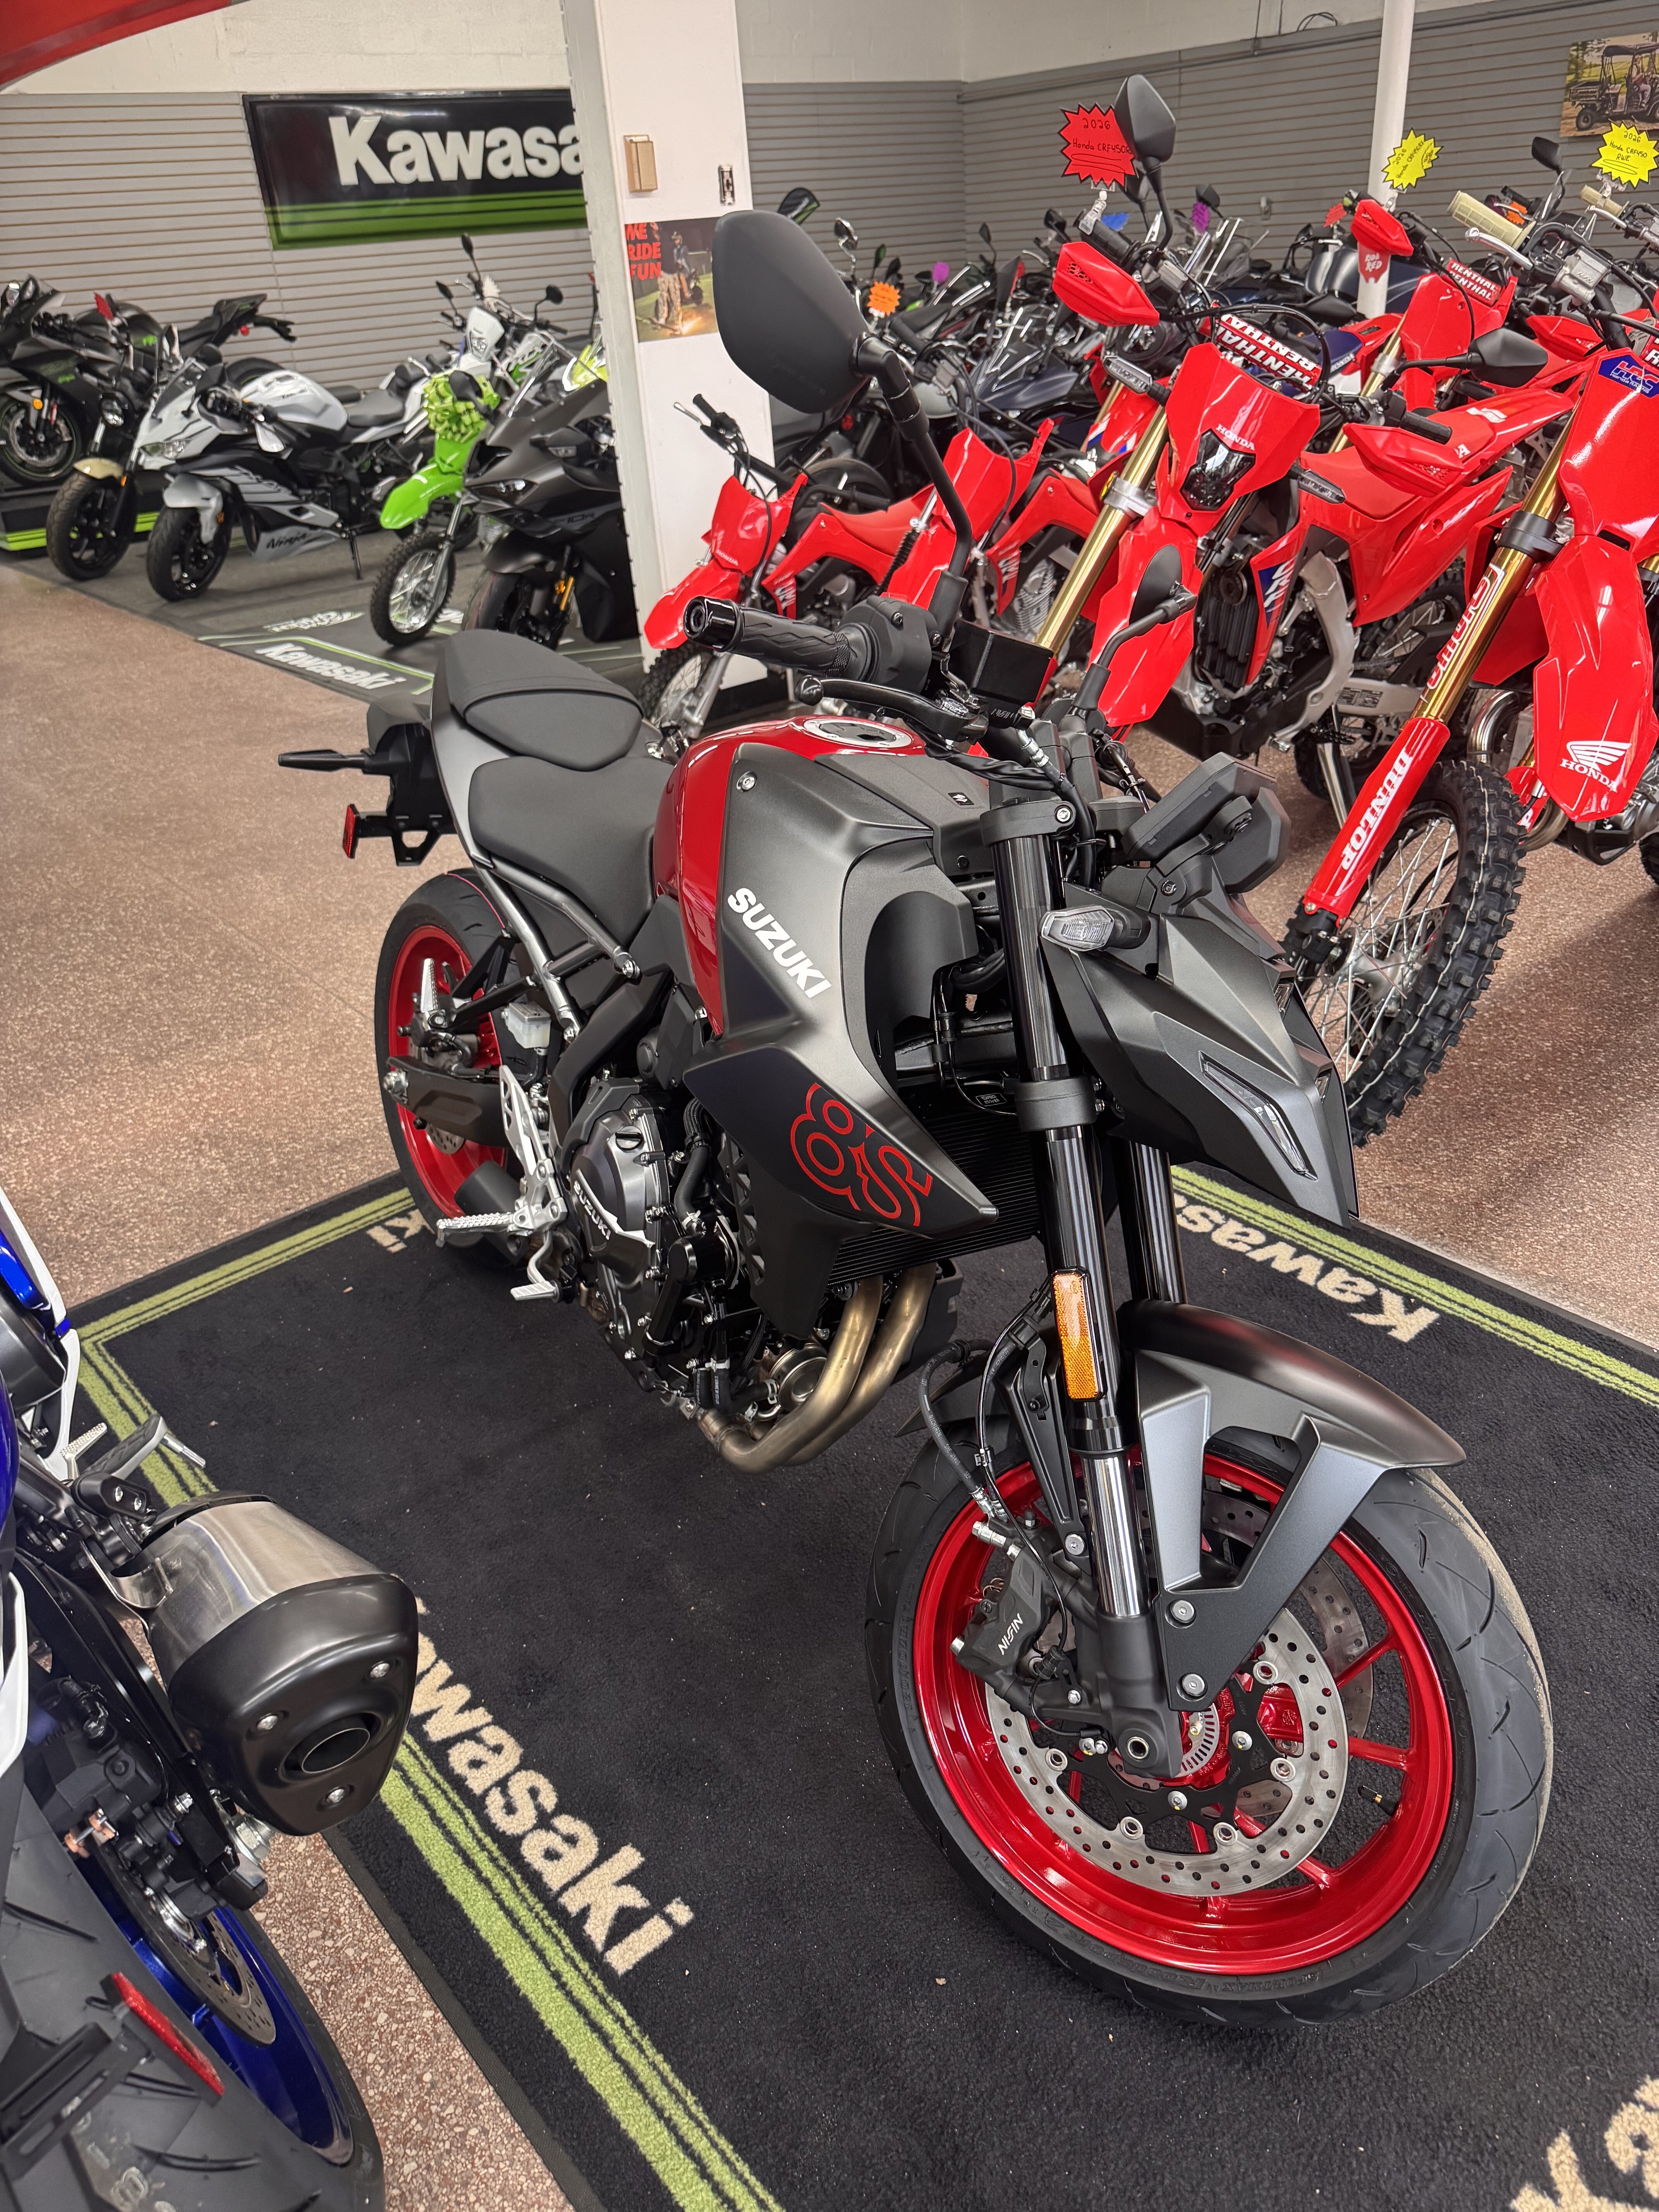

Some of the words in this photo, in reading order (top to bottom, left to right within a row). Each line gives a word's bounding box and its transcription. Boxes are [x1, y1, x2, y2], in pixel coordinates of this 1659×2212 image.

[1083, 118, 1110, 130] 2026
[1073, 138, 1094, 150] Honda
[1623, 131, 1641, 143] 2026
[1393, 148, 1407, 165] 2026
[1609, 140, 1624, 152] Honda
[1626, 147, 1648, 158] CRF450
[1616, 153, 1631, 162] RWE
[626, 222, 647, 241] WE
[628, 242, 661, 261] RIDE
[630, 261, 661, 282] FUN
[1365, 261, 1383, 273] RED
[1451, 262, 1496, 292] RENTHAL
[1449, 271, 1492, 301] RENTHAL
[1609, 373, 1630, 384] Honda
[1216, 424, 1255, 450] HONDA
[254, 642, 407, 690] Kawasaki
[1559, 758, 1618, 792] HONDA
[1341, 749, 1413, 871] DUNLOP
[727, 887, 832, 998] SUZUKI
[574, 1180, 611, 1240] SUZUKI
[1173, 1192, 1440, 1343] Kawas
[411, 1597, 694, 1976] wasaki
